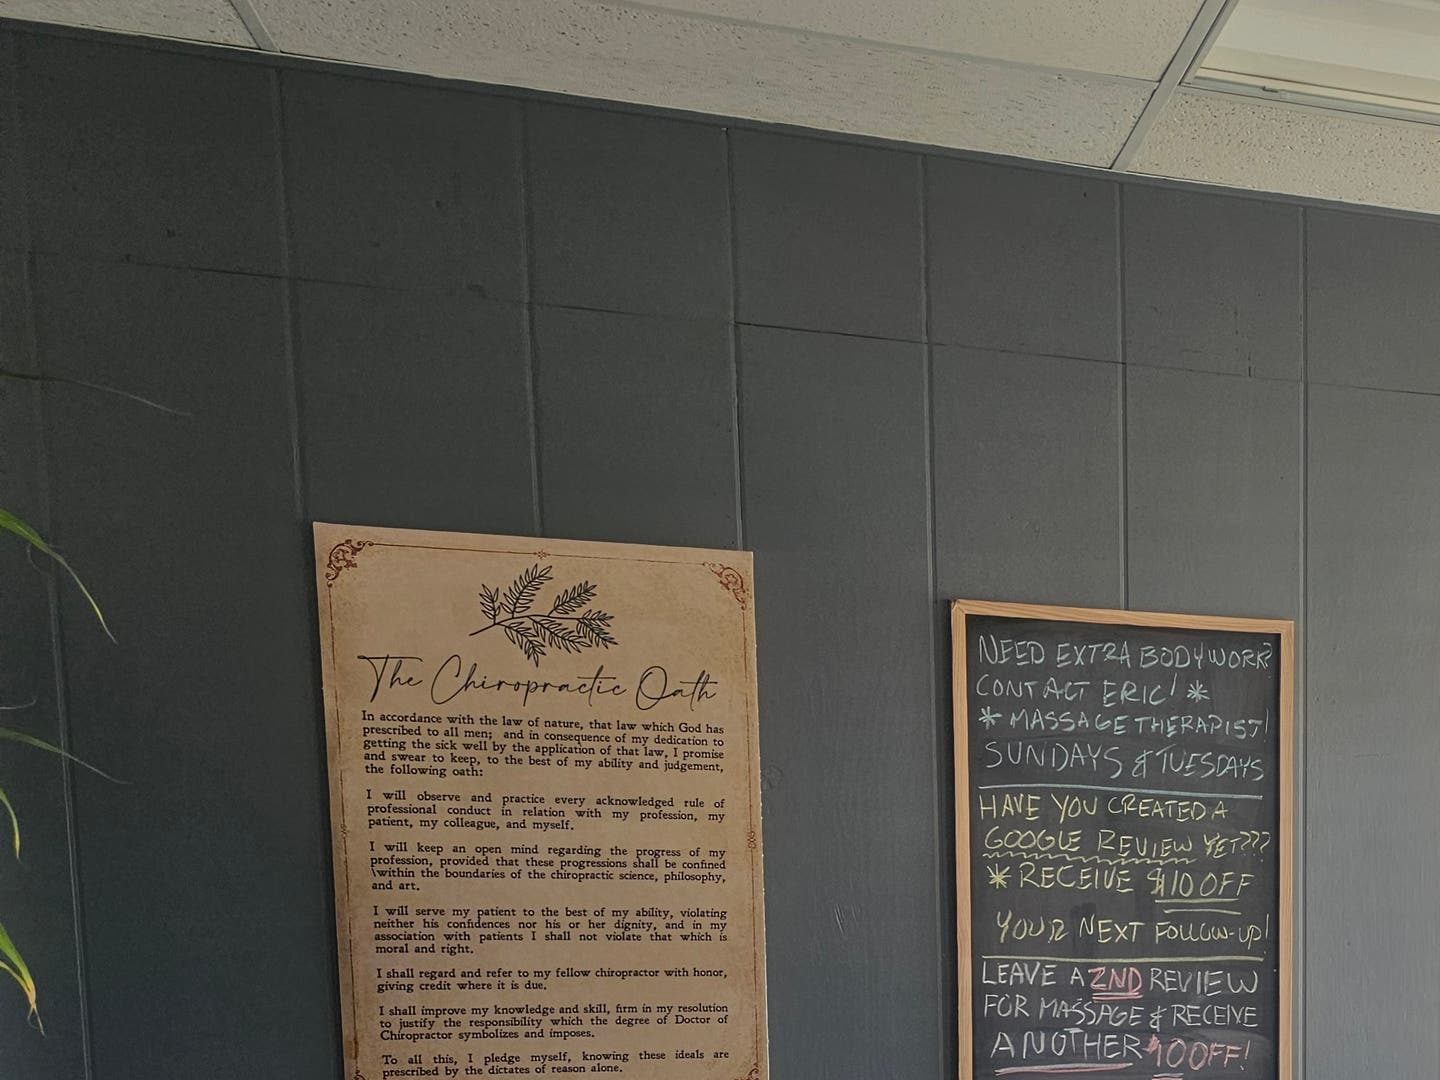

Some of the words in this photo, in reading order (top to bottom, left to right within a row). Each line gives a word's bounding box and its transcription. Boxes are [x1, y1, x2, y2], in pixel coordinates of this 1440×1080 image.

[979, 635, 1045, 666] NEED
[1057, 641, 1131, 669] EXTRA
[357, 654, 423, 702] The
[431, 655, 627, 707] Chiropractic
[636, 665, 718, 711] Oath
[976, 674, 1090, 700] CONTACT
[361, 709, 374, 721] In
[379, 712, 442, 724] accordance
[446, 713, 474, 725] with
[479, 714, 498, 726] the
[502, 715, 523, 726] law
[527, 716, 540, 727] of
[543, 720, 583, 730] nature,
[588, 719, 612, 730] that
[616, 719, 637, 730] law
[641, 721, 674, 732] which
[678, 722, 702, 734] God
[705, 723, 724, 734] has
[1010, 708, 1129, 736] MASSAGE
[1135, 707, 1269, 743] THERAPIST!
[364, 763, 384, 774] the
[390, 763, 447, 778] following
[451, 765, 483, 777] oath:
[985, 741, 1123, 779] SUNDAYS
[1131, 749, 1154, 779] &
[1156, 743, 1265, 781] TUESDAYS
[366, 803, 436, 816] professional
[446, 805, 491, 816] conduct
[501, 808, 512, 816] in
[522, 806, 565, 817] relation
[574, 807, 601, 818] with
[611, 811, 629, 822] my
[639, 809, 697, 822] profession,
[707, 813, 725, 824] my
[367, 817, 413, 829] patient,
[419, 819, 438, 830] my
[443, 816, 499, 831] colleague,
[505, 818, 527, 829] and
[532, 819, 574, 832] myself.
[979, 794, 1040, 820] HAVE
[1051, 793, 1097, 824] YOU
[1107, 794, 1207, 822] CREATED
[1211, 801, 1229, 820] A
[984, 826, 1082, 851] GOOGLE
[1097, 829, 1193, 857] REVIEW
[1203, 831, 1271, 862] YET???
[369, 854, 433, 868] profession,
[439, 855, 490, 869] provided
[495, 856, 519, 866] that
[525, 856, 554, 867] these
[559, 857, 627, 870] progressions
[632, 857, 659, 868] shall
[664, 858, 677, 869] be
[681, 859, 727, 870] confined
[1019, 861, 1134, 892] RECEIVE
[997, 910, 1068, 944] YOUR
[1079, 913, 1145, 944] NEXT
[375, 942, 408, 954] moral
[414, 943, 436, 954] and
[440, 943, 473, 956] right.
[982, 960, 1057, 988] LEAVE
[1070, 967, 1085, 987] A
[1088, 966, 1143, 991] 2ND
[1150, 967, 1258, 996] REVIEW
[983, 994, 1030, 1018] FOR
[1039, 998, 1145, 1026] MASSAGE
[1149, 1006, 1168, 1032] &
[1171, 1004, 1258, 1027] RECEIVE
[379, 1029, 453, 1043] Chiropractor
[458, 1028, 519, 1042] symbolizes
[523, 1028, 544, 1038] and
[549, 1027, 594, 1041] imposes.
[990, 1027, 1143, 1060] ANOTHER
[382, 1066, 439, 1080] prescribed
[444, 1065, 459, 1079] by
[464, 1065, 483, 1075] the
[487, 1064, 530, 1075] dictates
[534, 1063, 546, 1074] of
[551, 1065, 585, 1073] reason
[590, 1062, 622, 1072] alone.
